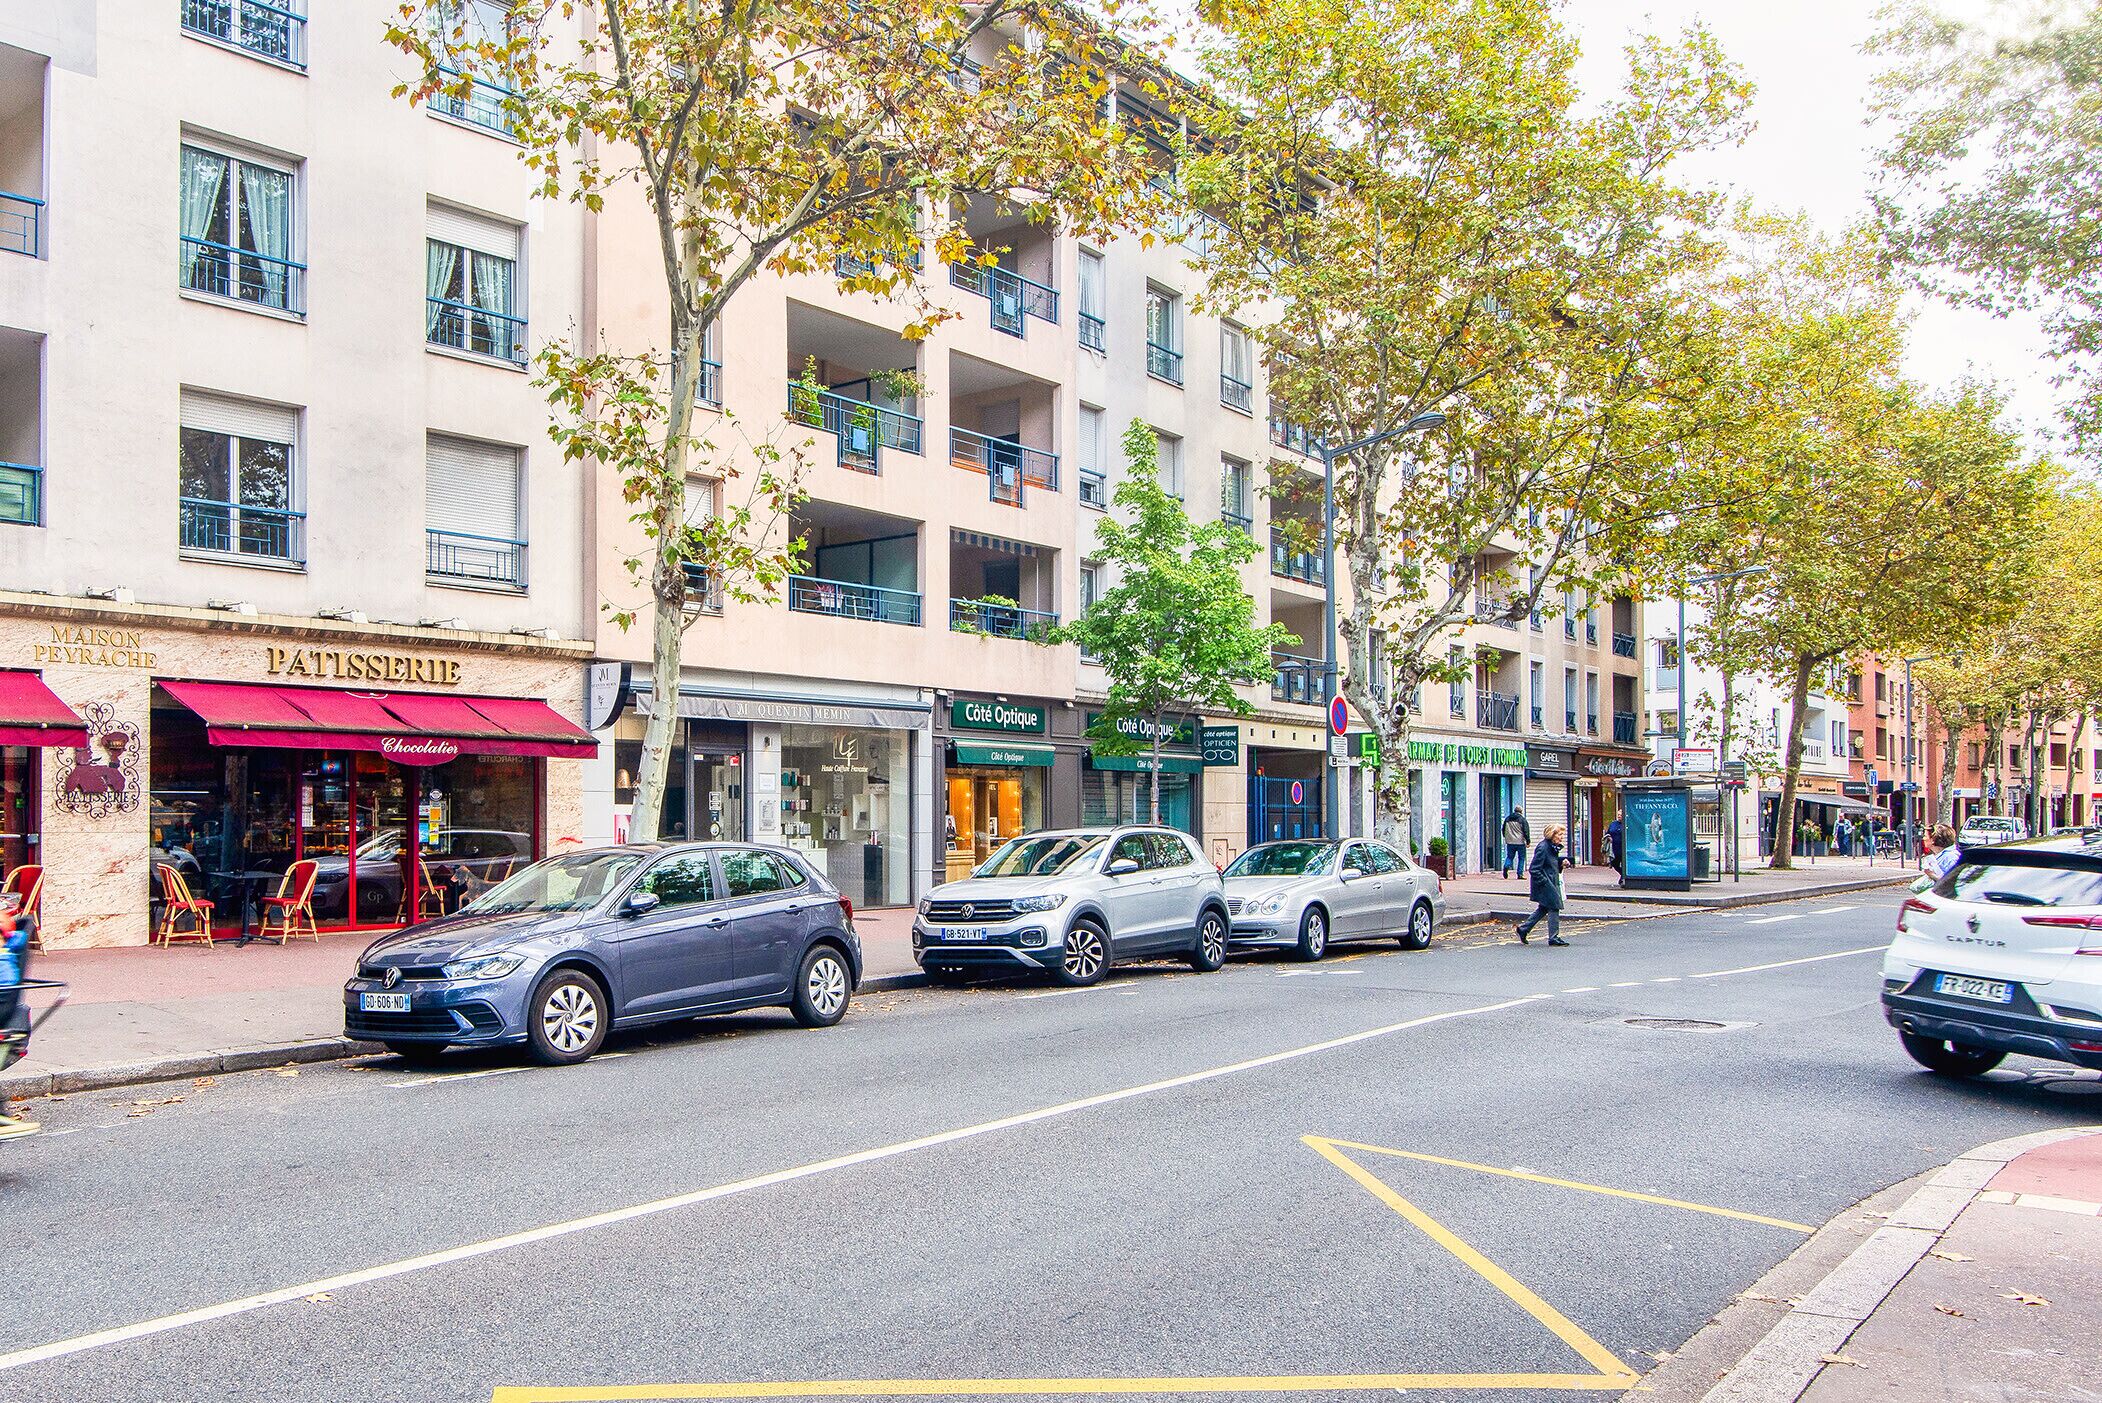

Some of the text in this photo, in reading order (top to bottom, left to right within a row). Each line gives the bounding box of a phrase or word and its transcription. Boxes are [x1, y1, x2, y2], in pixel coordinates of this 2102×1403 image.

[50, 625, 141, 649] MAISON
[33, 644, 158, 669] PEYRACHE
[267, 646, 462, 684] PATISSERIE
[757, 704, 811, 718] QUENTIN
[965, 703, 1038, 729] Côté Optique
[1116, 717, 1174, 740] Côté Optque
[381, 737, 459, 755] Chocolatier
[1203, 740, 1237, 748] OPTICIEN
[1445, 744, 1457, 763] DE
[990, 752, 1025, 763] Côté Optique
[1946, 935, 2006, 948] CAPTUR
